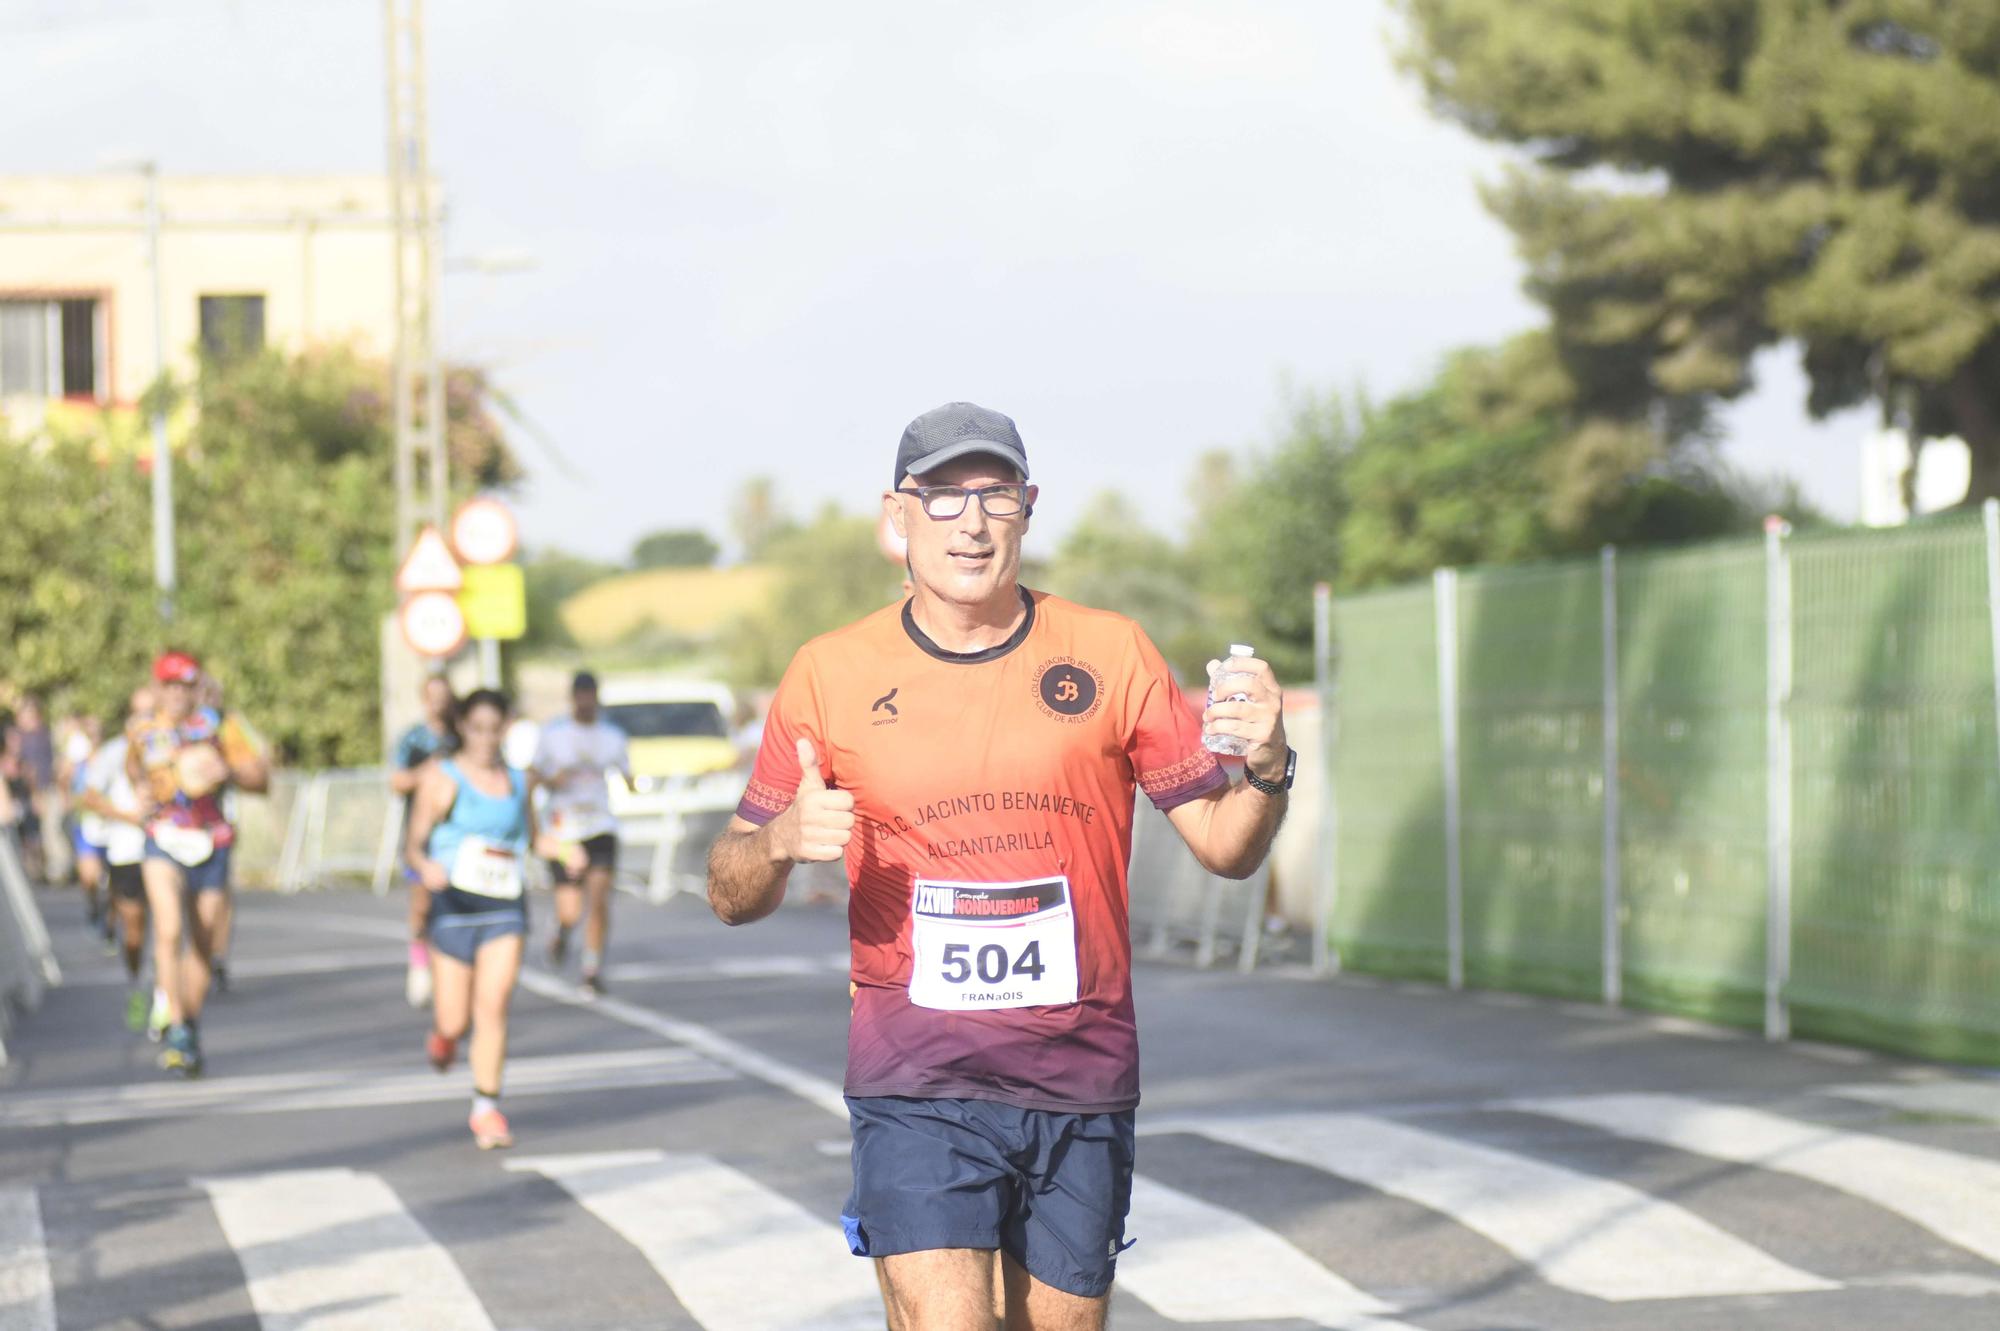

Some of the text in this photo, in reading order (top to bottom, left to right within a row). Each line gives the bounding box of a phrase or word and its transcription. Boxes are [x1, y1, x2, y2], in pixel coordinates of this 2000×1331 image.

[1031, 656, 1104, 698] COLEGIO JACINTO BENAVENTE
[1036, 699, 1102, 724] CLUB DE ATLETISMO
[914, 793, 996, 827] JACINTO
[1002, 791, 1096, 825] BENAVENTE
[927, 831, 1054, 860] ALCANTARILLA
[955, 896, 1039, 916] NONDUERMAS
[941, 940, 1046, 984] 504
[961, 991, 1024, 1001] FRANaOIS
